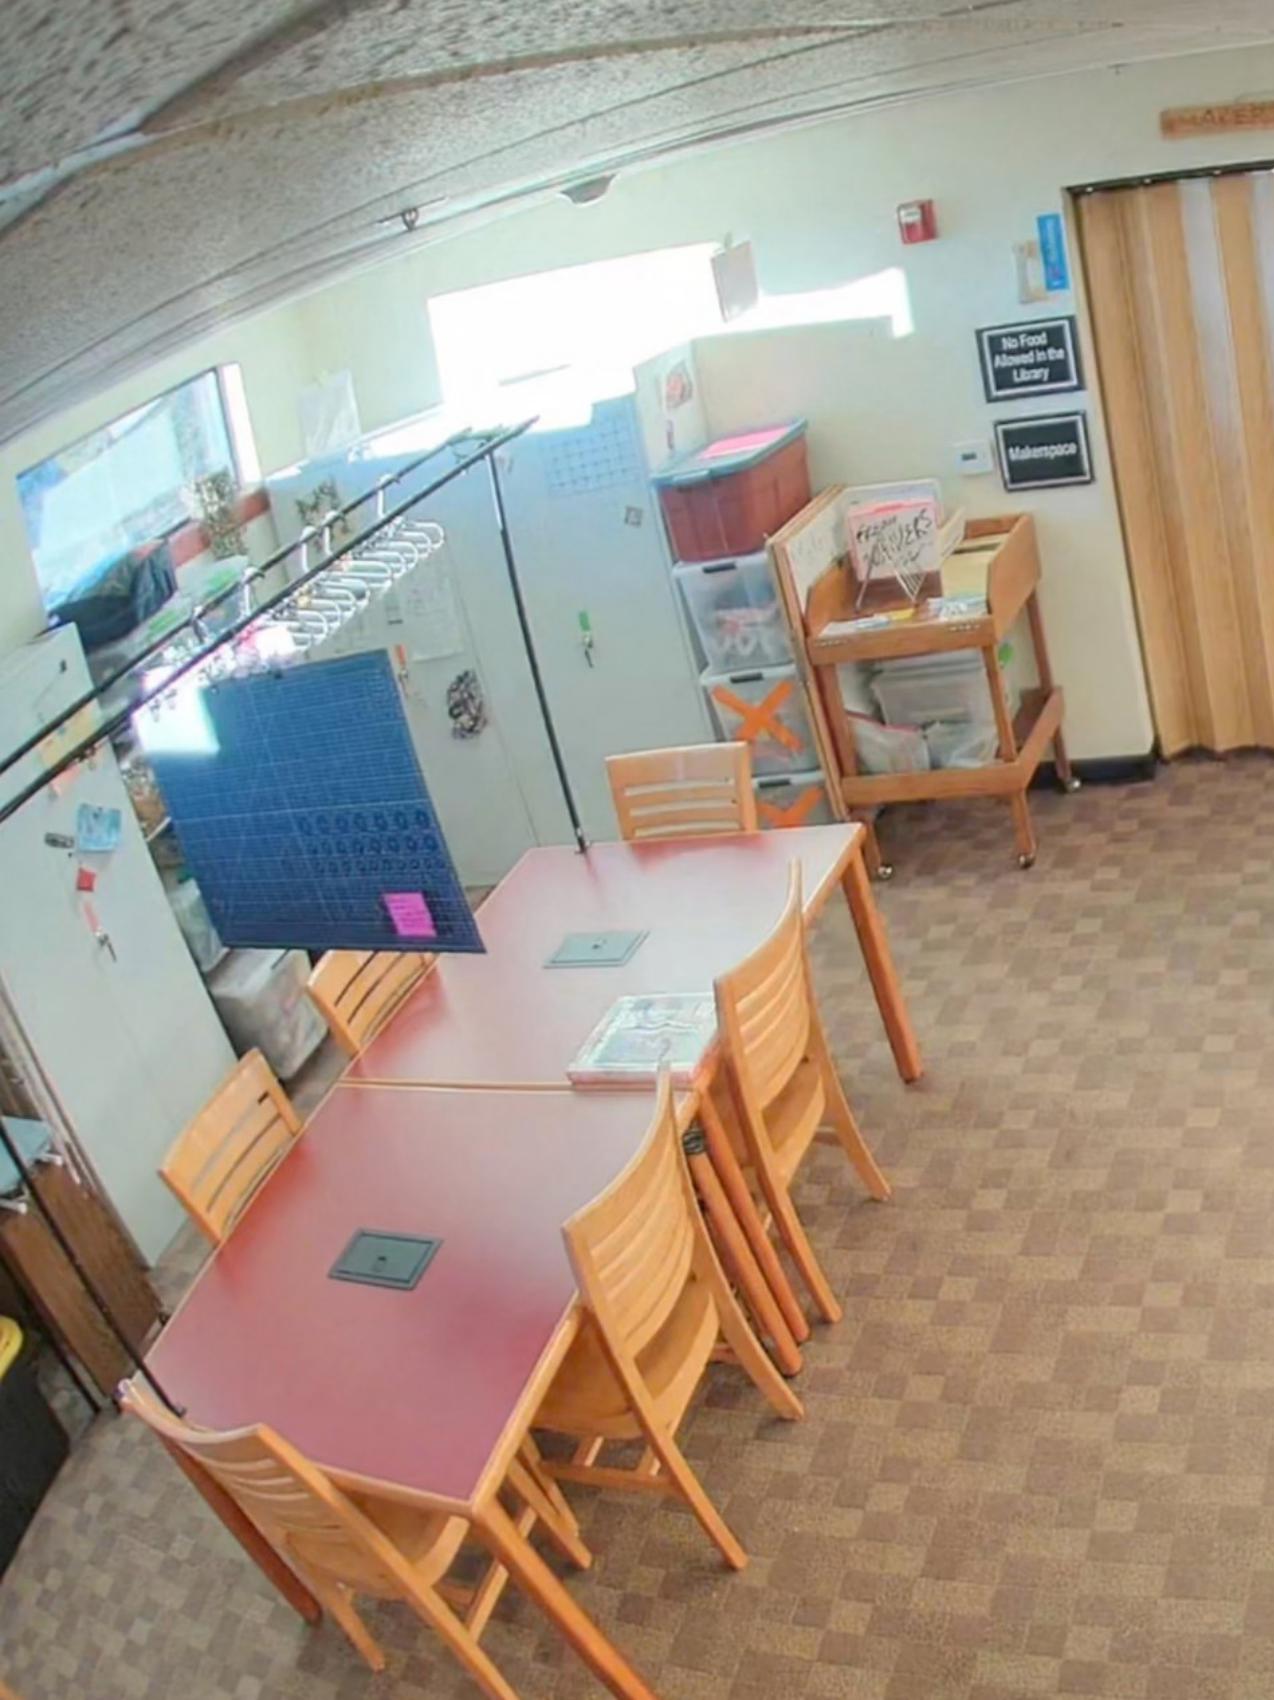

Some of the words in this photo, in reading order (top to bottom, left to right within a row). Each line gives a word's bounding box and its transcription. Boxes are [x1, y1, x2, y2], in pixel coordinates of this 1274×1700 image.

[1002, 336, 1018, 350] No
[1020, 332, 1047, 347] Food
[994, 351, 1034, 368] Allowed
[1036, 349, 1046, 361] in
[1047, 347, 1065, 360] the
[1012, 366, 1050, 382] Library
[1008, 442, 1077, 460] Makerspace
